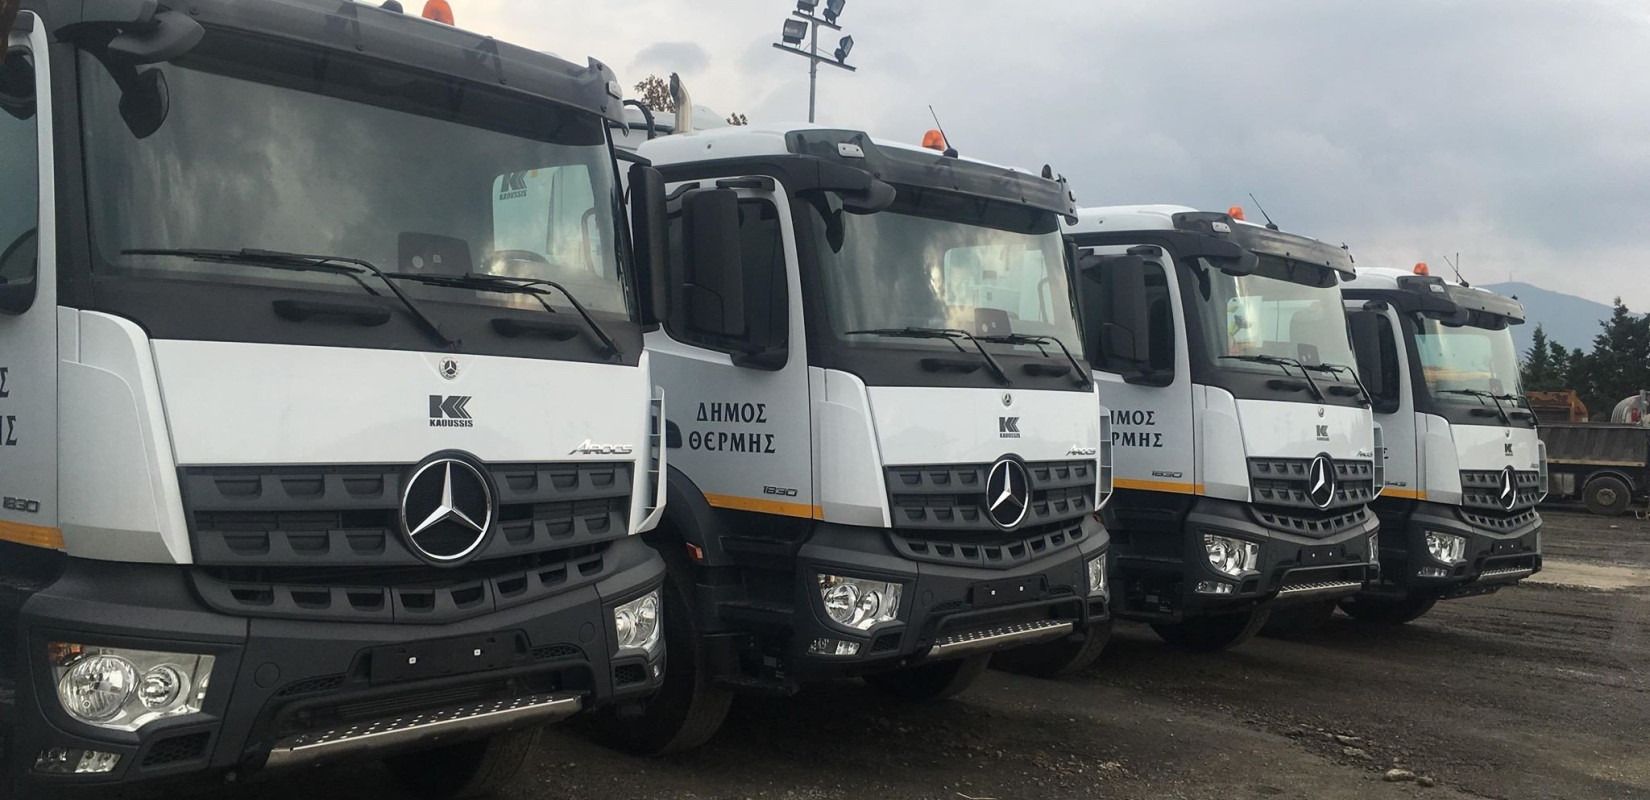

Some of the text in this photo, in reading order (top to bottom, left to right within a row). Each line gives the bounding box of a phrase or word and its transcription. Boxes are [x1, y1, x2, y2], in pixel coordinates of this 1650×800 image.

[696, 402, 768, 424] ΔΗΜΟΣ
[428, 419, 474, 428] KAOUSSIS
[689, 431, 776, 454] ΘΕΡΜΗΣ
[1111, 431, 1164, 448] ΡΜΗΣ
[763, 486, 798, 497] 1830
